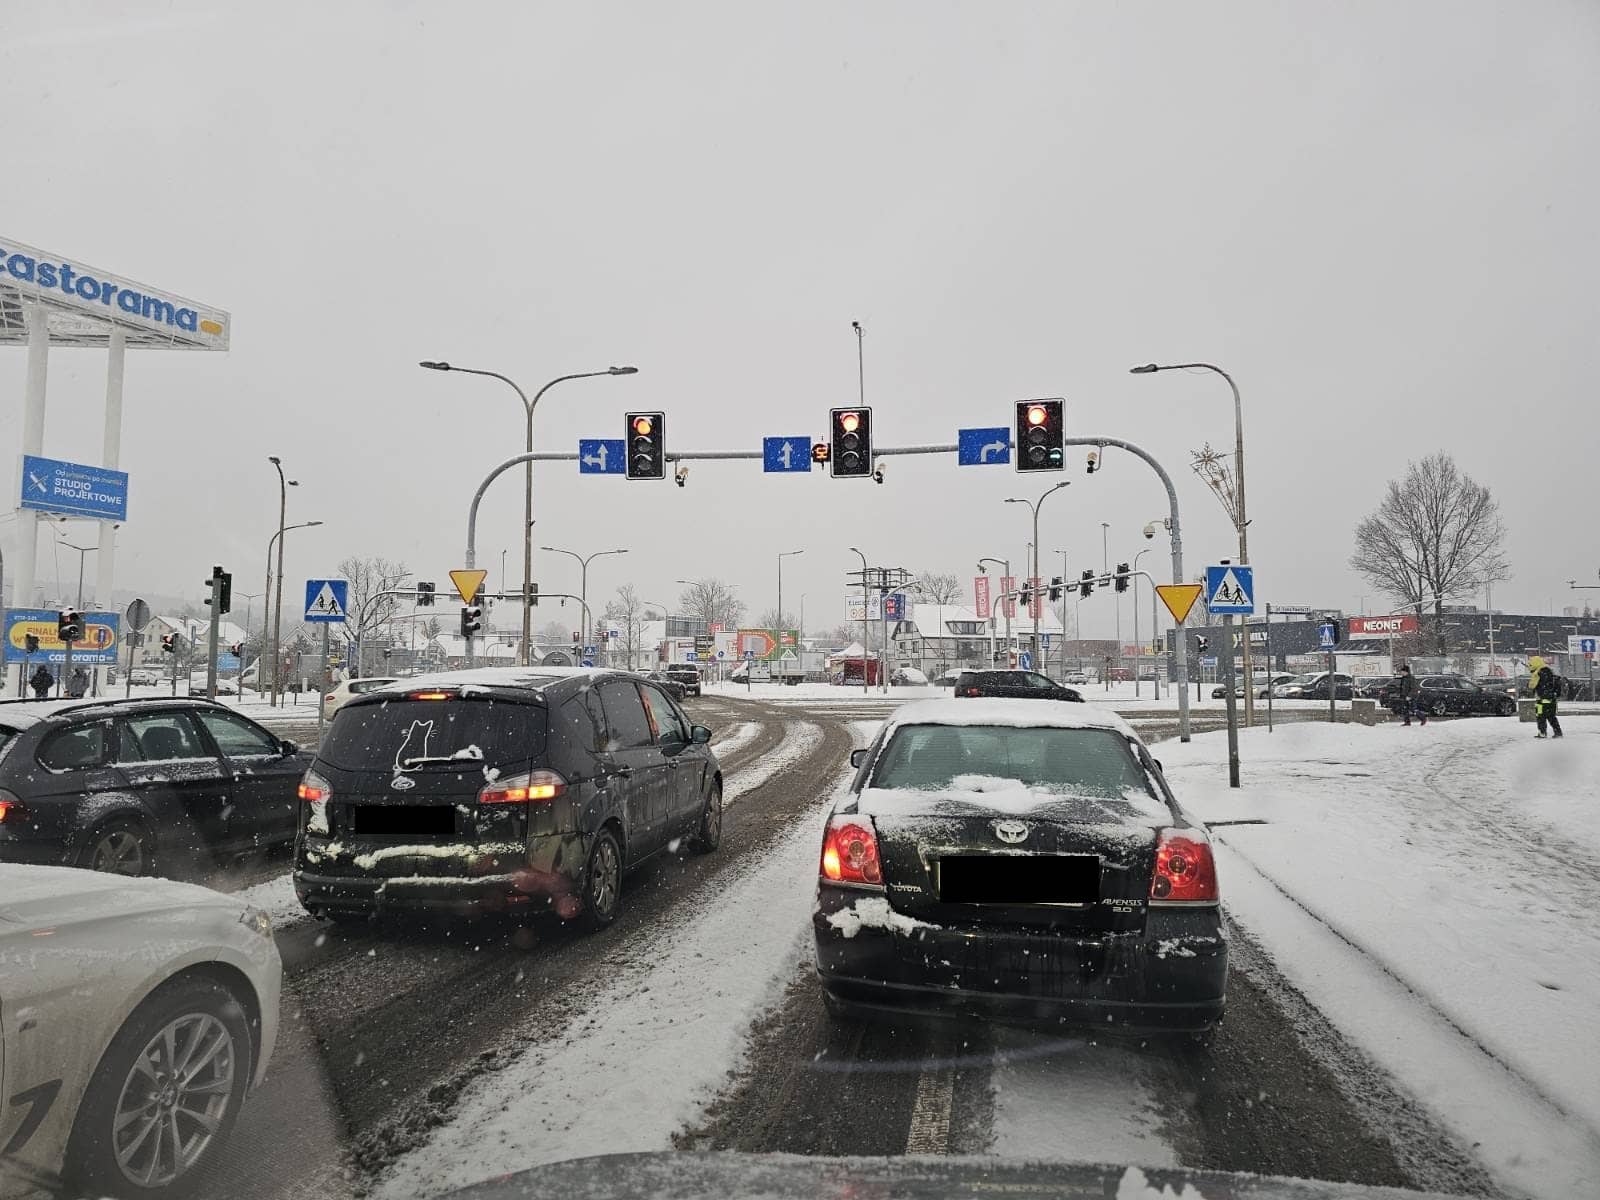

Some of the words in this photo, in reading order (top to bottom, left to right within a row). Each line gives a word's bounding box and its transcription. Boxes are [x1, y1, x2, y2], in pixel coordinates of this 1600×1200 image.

[54, 477, 92, 491] STUDIO
[54, 486, 122, 505] PROJEKTOWE
[1363, 619, 1403, 631] NEONET
[48, 653, 106, 662] casorama
[893, 885, 922, 893] TOYOTA
[1101, 898, 1143, 907] AVENSIS
